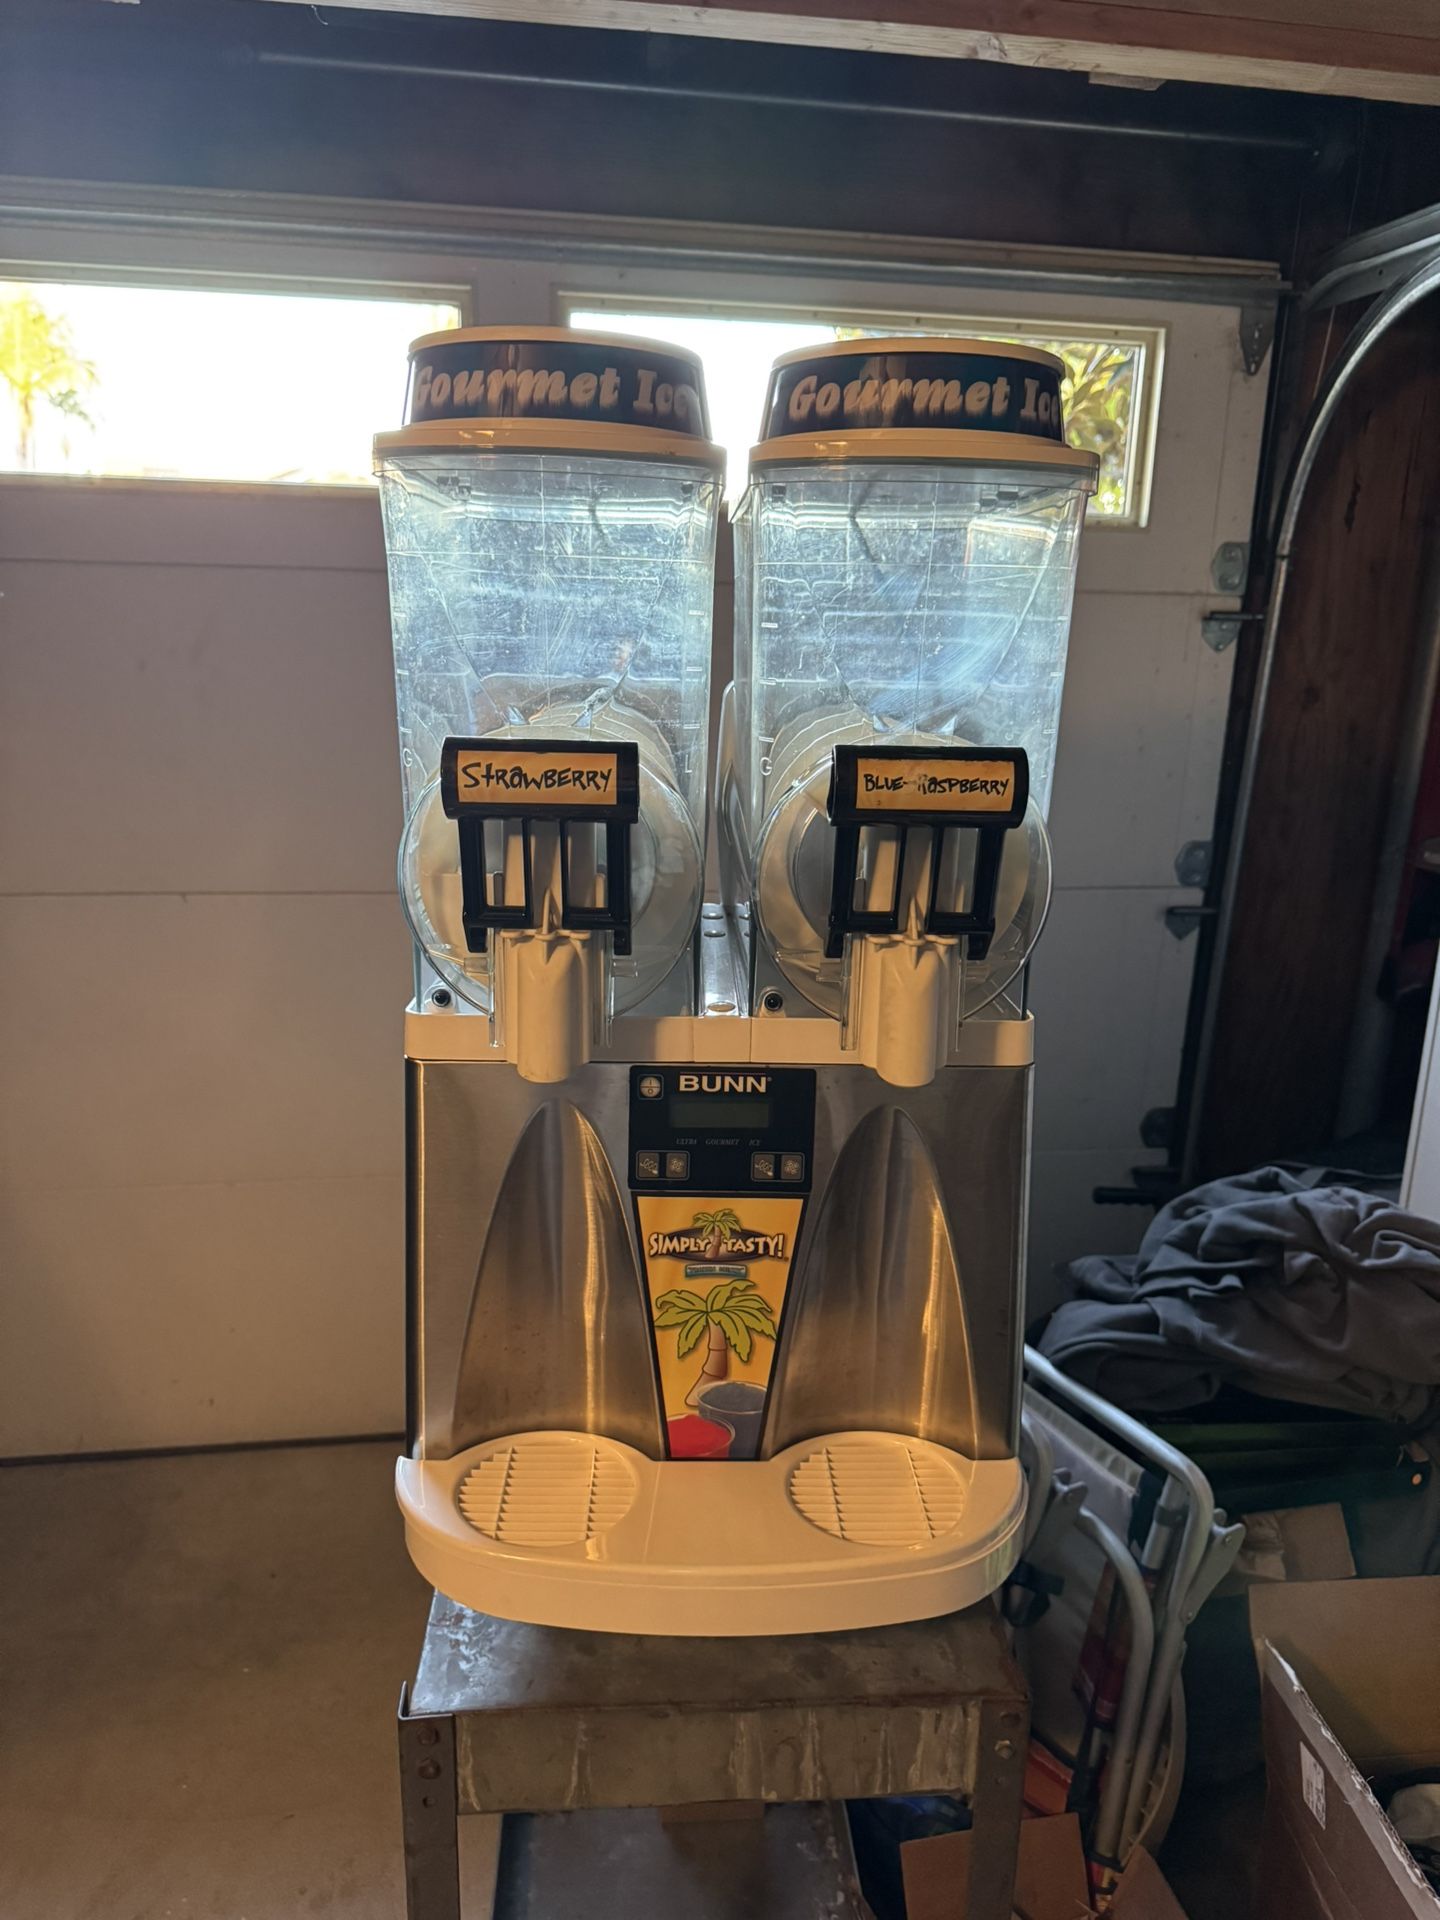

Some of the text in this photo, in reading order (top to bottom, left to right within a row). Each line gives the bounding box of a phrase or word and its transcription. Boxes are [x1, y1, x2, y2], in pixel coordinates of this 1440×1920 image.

[416, 364, 620, 409] Gourmet
[789, 375, 1011, 420] Gourmet
[403, 748, 412, 767] G
[760, 757, 772, 776] G
[679, 1075, 767, 1093] BUNN
[705, 1137, 740, 1146] GOURMET
[748, 1138, 761, 1146] ICE
[649, 1232, 784, 1258] SIMPLY TASTY!
